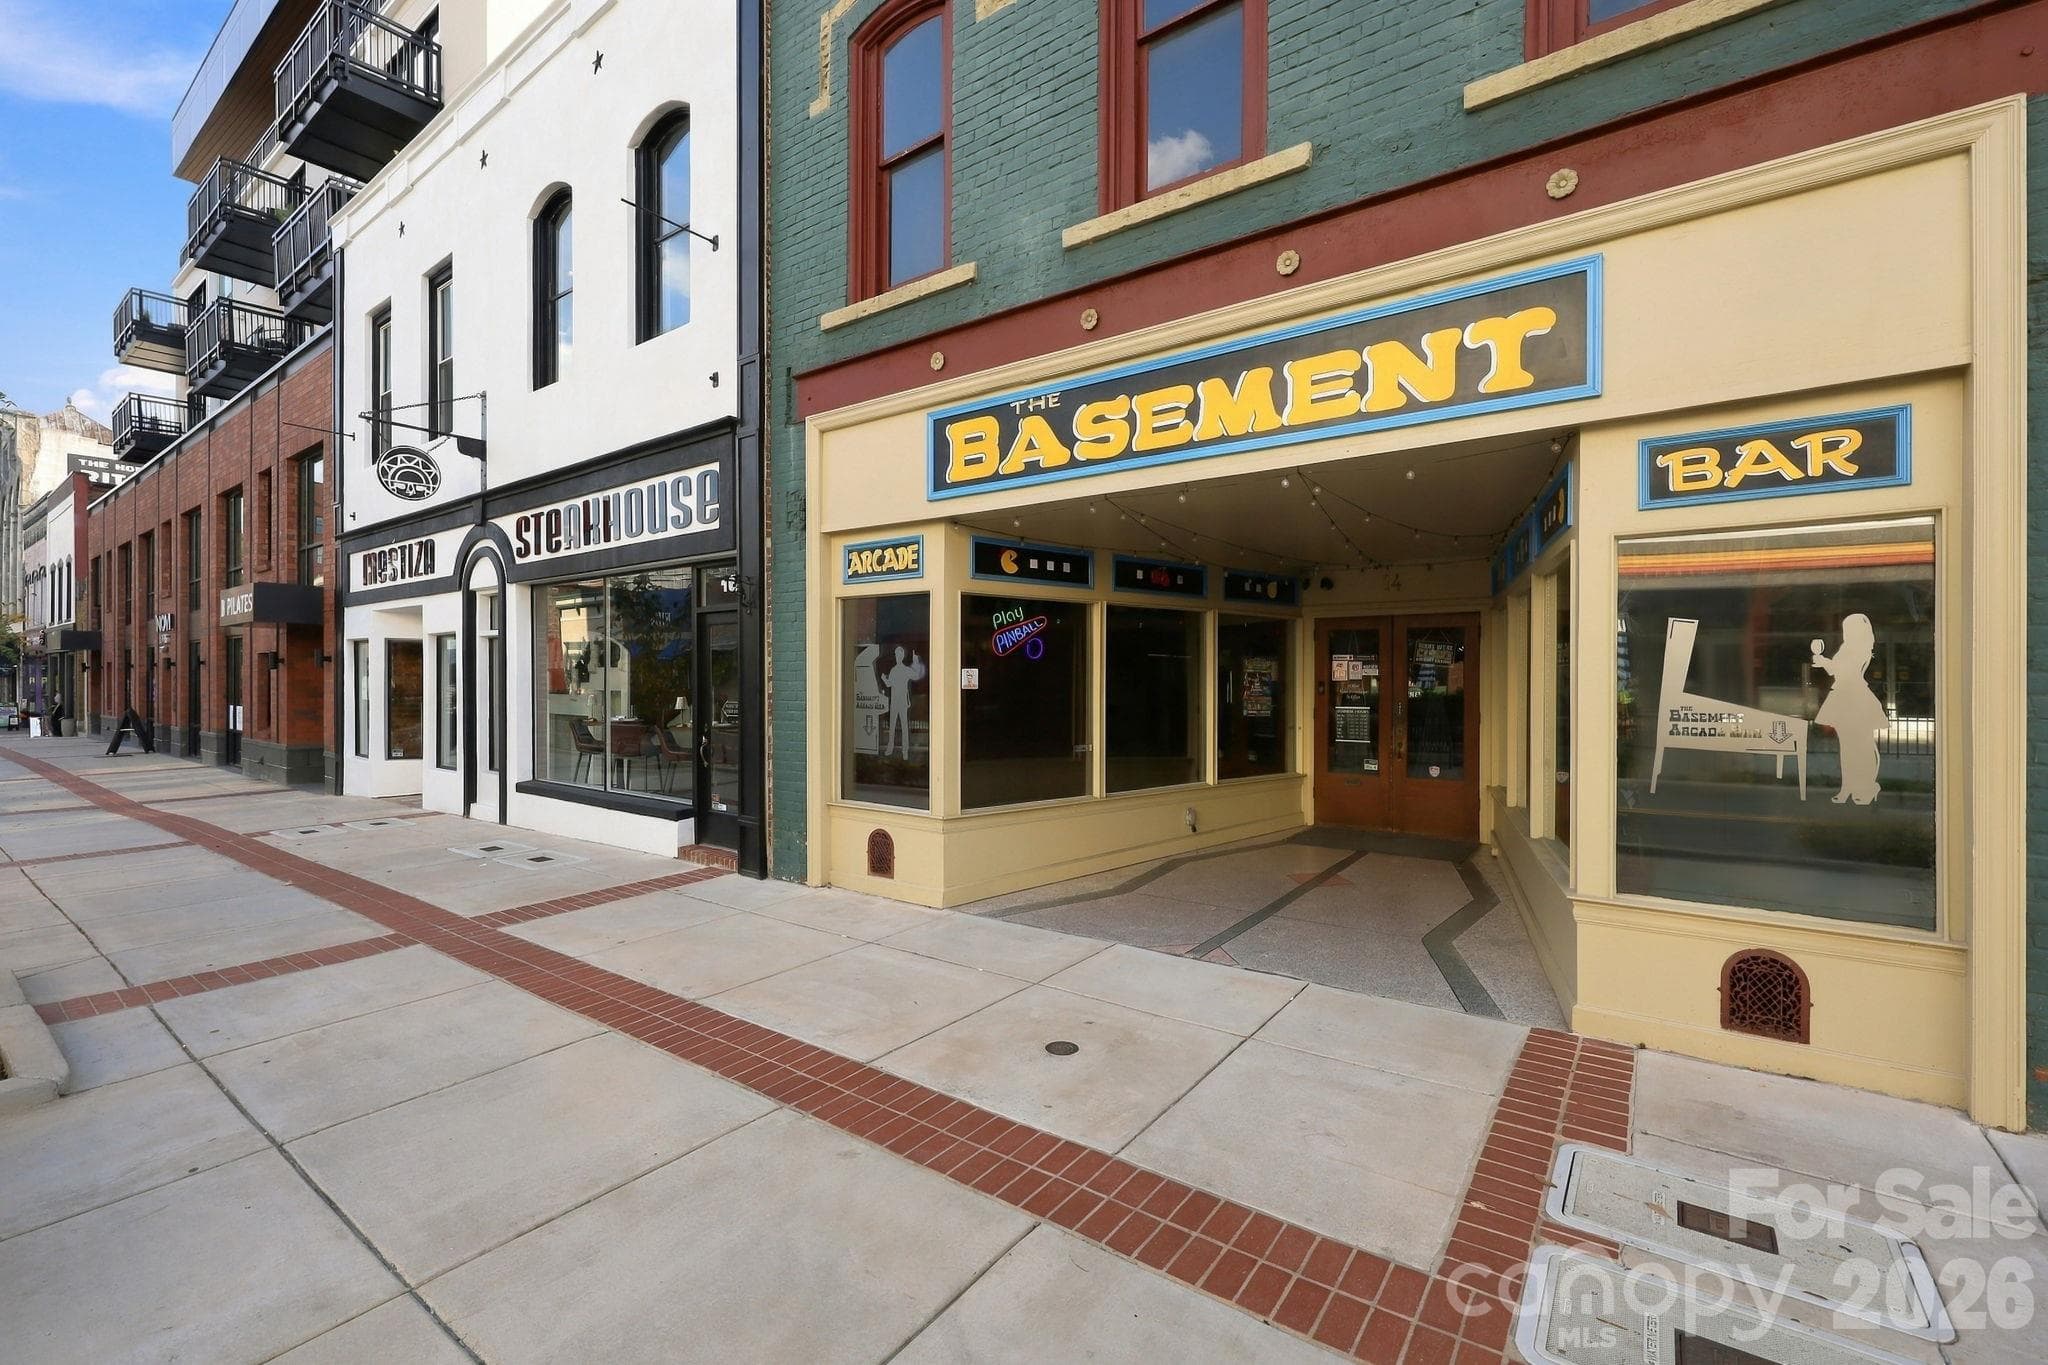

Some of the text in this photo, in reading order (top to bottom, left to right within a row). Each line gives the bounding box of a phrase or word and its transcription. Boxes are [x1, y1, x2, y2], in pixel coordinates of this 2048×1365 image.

[945, 306, 1557, 483] BASEMENT
[1010, 391, 1061, 415] THE
[78, 458, 110, 469] THE
[1656, 428, 1863, 493] BAR
[848, 543, 919, 576] ARCADE
[227, 592, 253, 616] PILATES
[992, 606, 1024, 630] Play
[996, 620, 1044, 654] PINBALL
